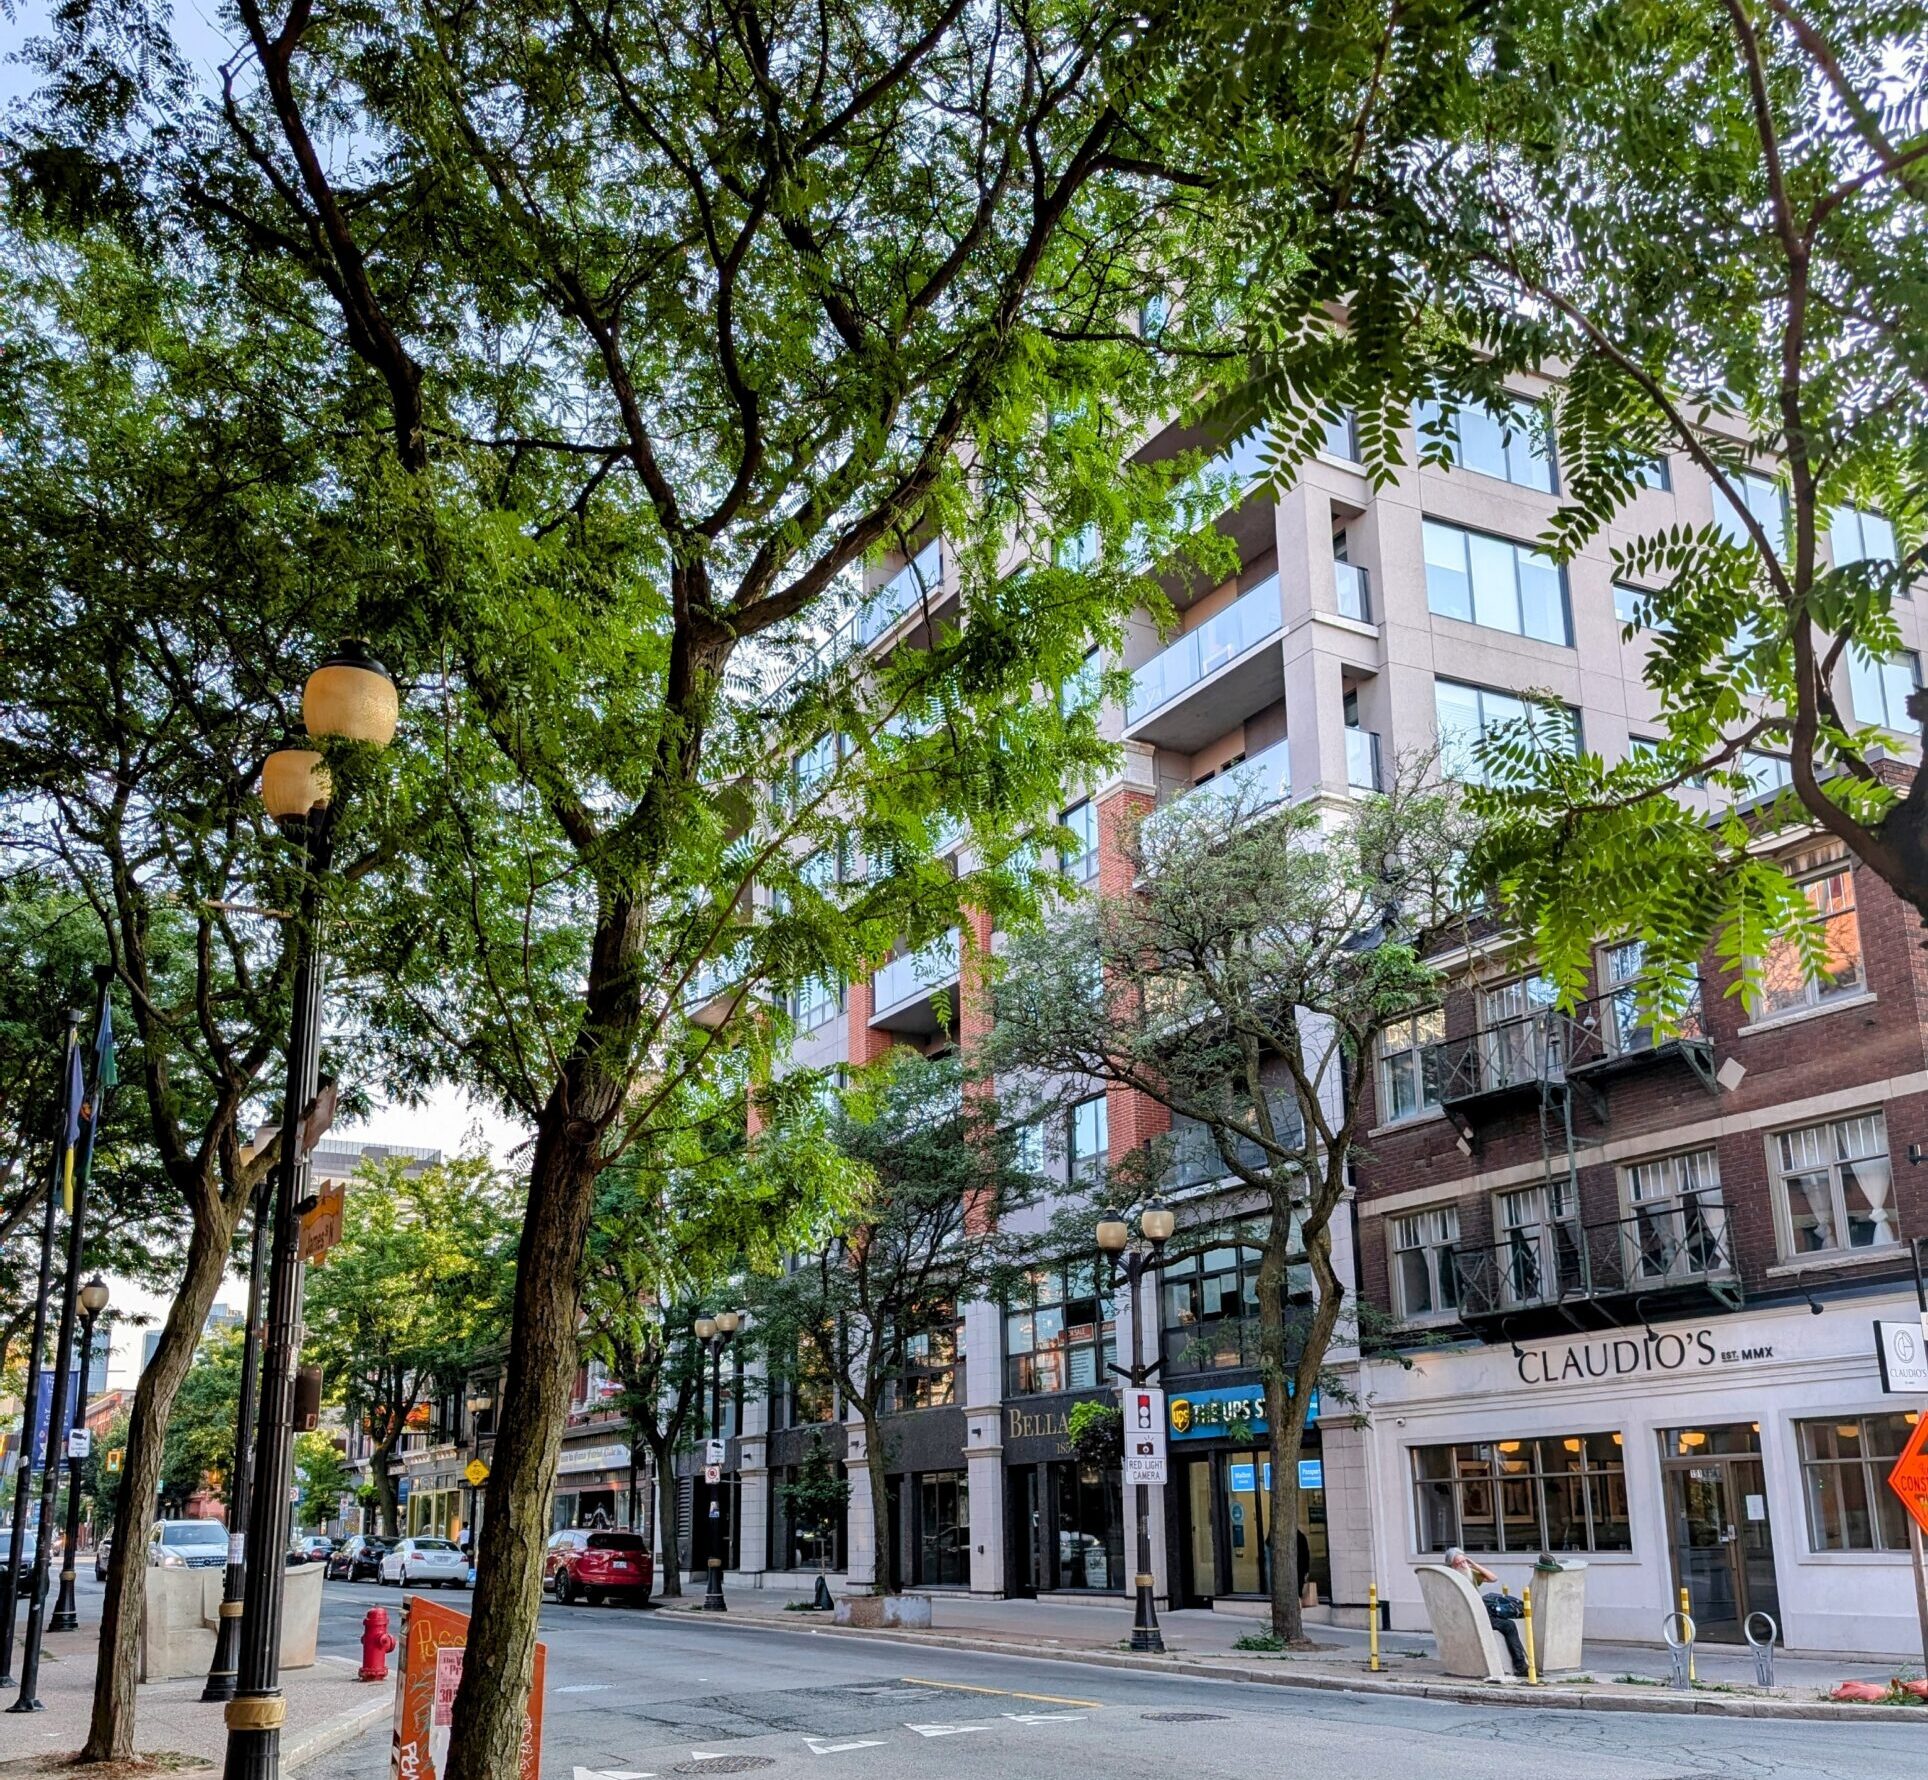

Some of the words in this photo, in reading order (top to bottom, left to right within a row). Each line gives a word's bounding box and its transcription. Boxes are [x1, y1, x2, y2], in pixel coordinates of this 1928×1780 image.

[1517, 1329, 1716, 1384] CLAUDIO'S
[1741, 1346, 1775, 1361] MMX
[1889, 1368, 1928, 1378] CLAUDIO'S
[1192, 1403, 1219, 1424] THE
[1222, 1399, 1251, 1422] UPS
[1008, 1408, 1070, 1439] BELLA
[1128, 1460, 1142, 1470] RED
[1144, 1460, 1163, 1470] LIGHT
[1132, 1471, 1161, 1480] CAMERA
[1901, 1475, 1928, 1491] CONS
